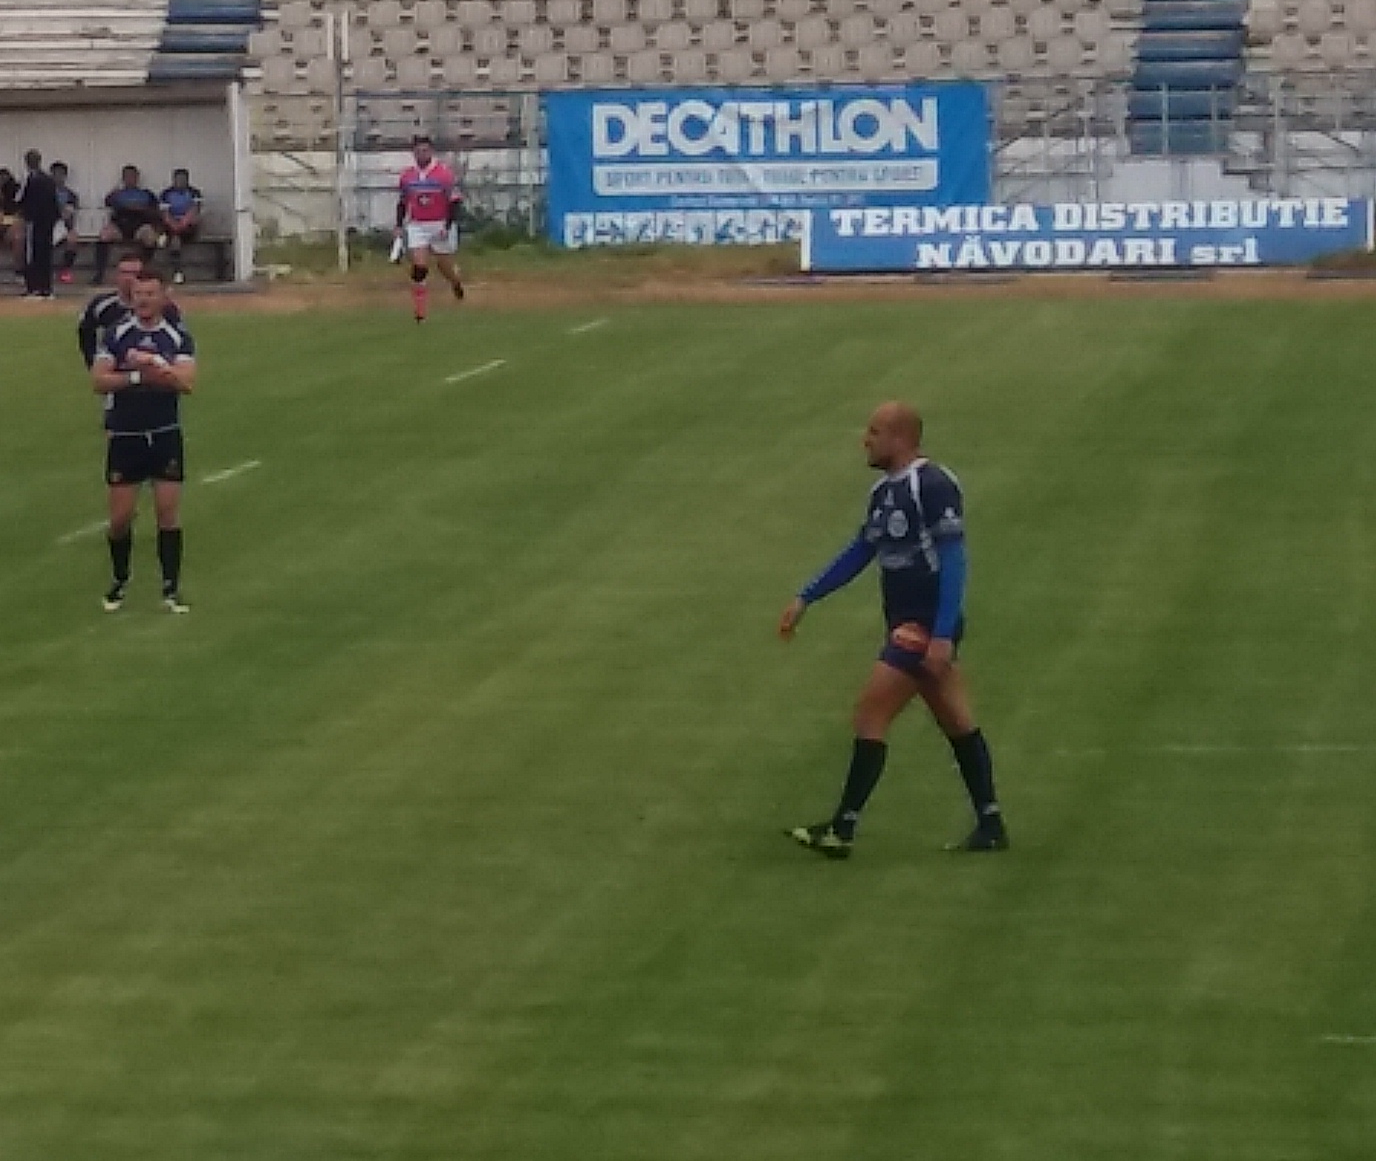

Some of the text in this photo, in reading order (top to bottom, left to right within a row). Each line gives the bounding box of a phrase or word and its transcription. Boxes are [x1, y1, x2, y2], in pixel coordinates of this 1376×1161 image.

[592, 98, 938, 156] DECATHLON
[829, 202, 1040, 236] TERMICA
[1052, 197, 1348, 231] DISTRIBUTIE
